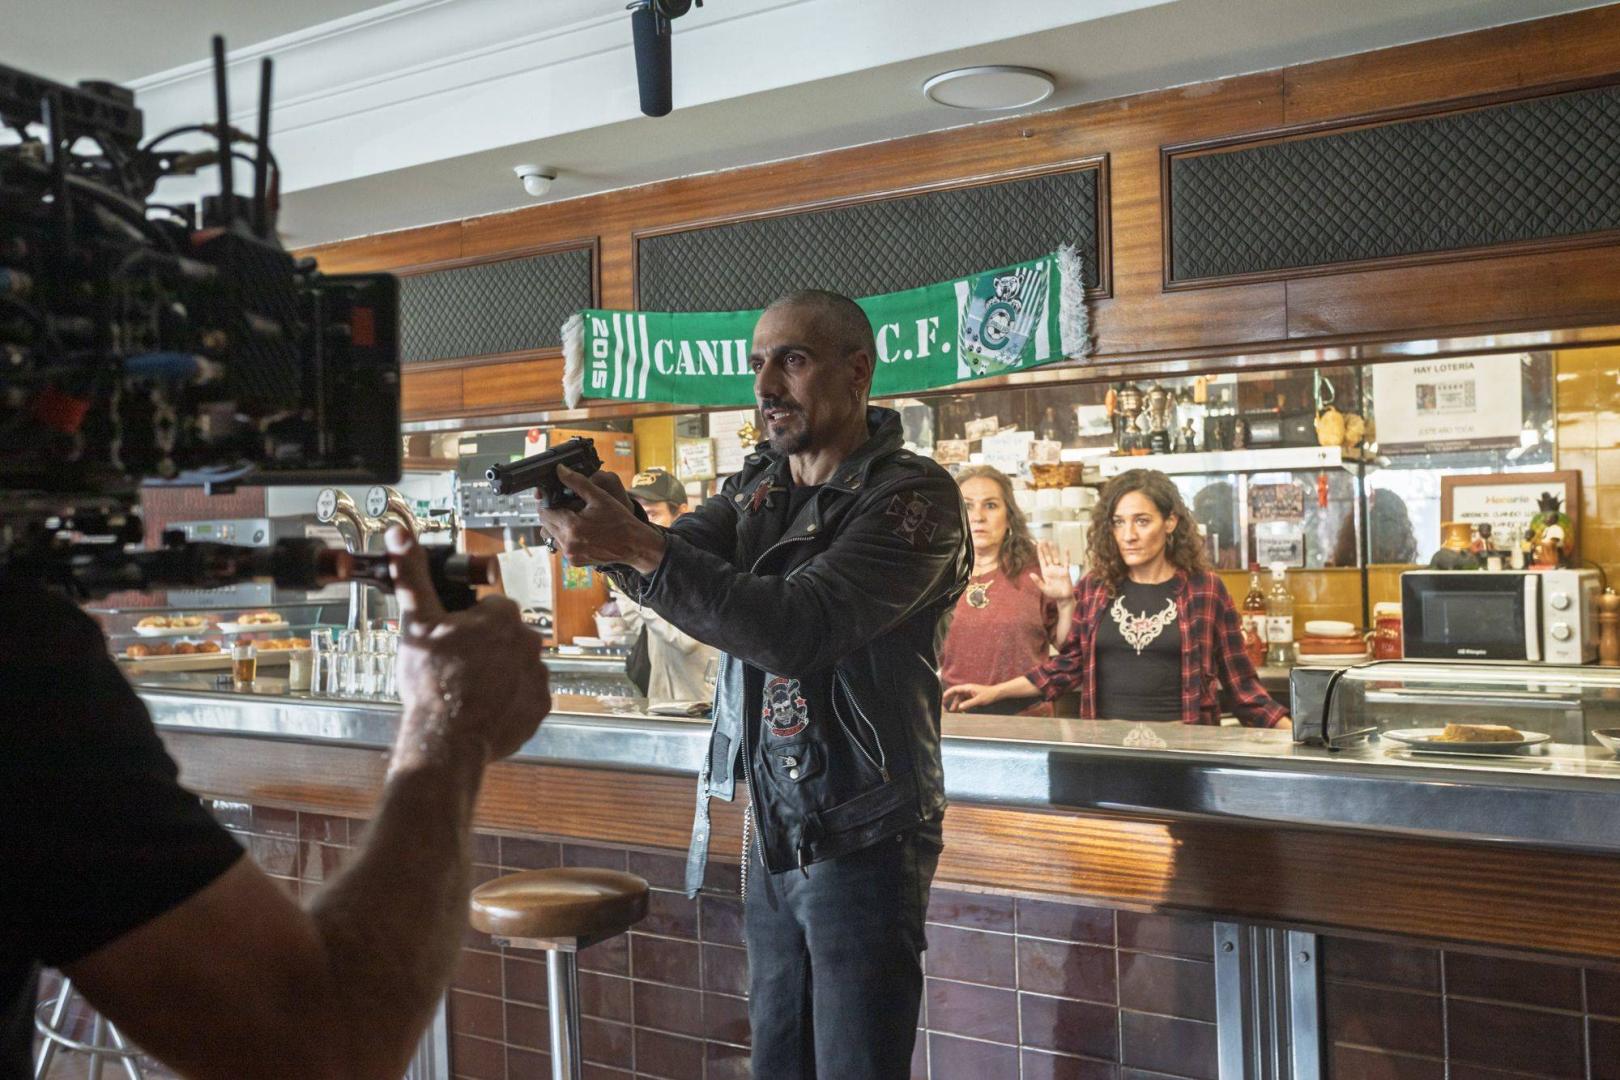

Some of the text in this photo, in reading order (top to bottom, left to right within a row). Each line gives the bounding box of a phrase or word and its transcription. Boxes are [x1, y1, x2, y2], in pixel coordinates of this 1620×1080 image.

[592, 317, 609, 389] 2015
[654, 316, 951, 376] CANIL C.F.
[1413, 366, 1431, 374] HAY
